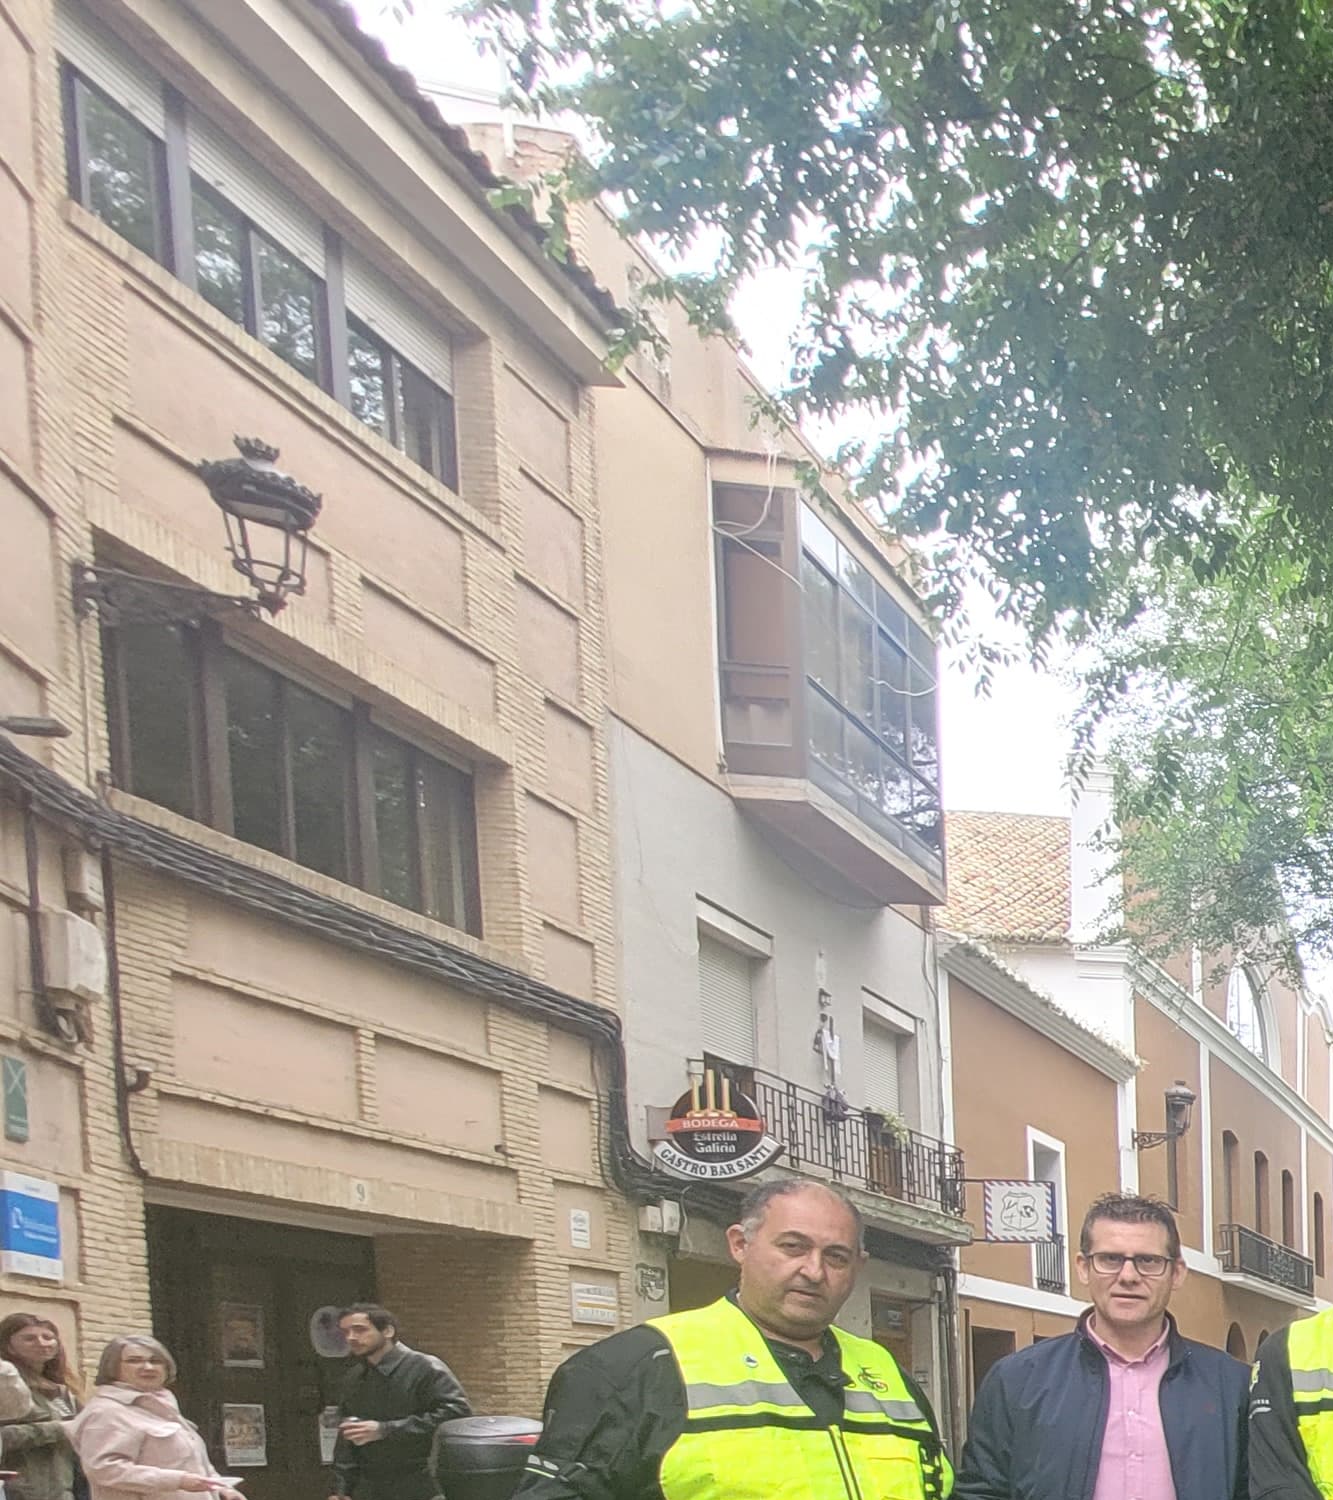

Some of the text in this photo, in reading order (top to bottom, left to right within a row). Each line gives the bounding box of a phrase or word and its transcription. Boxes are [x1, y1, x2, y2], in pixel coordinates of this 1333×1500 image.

[683, 1119, 739, 1128] BODEGA
[694, 1132, 737, 1141] Estrella
[695, 1142, 736, 1153] Galicia
[660, 1145, 771, 1176] GASTRO BAR SANTI
